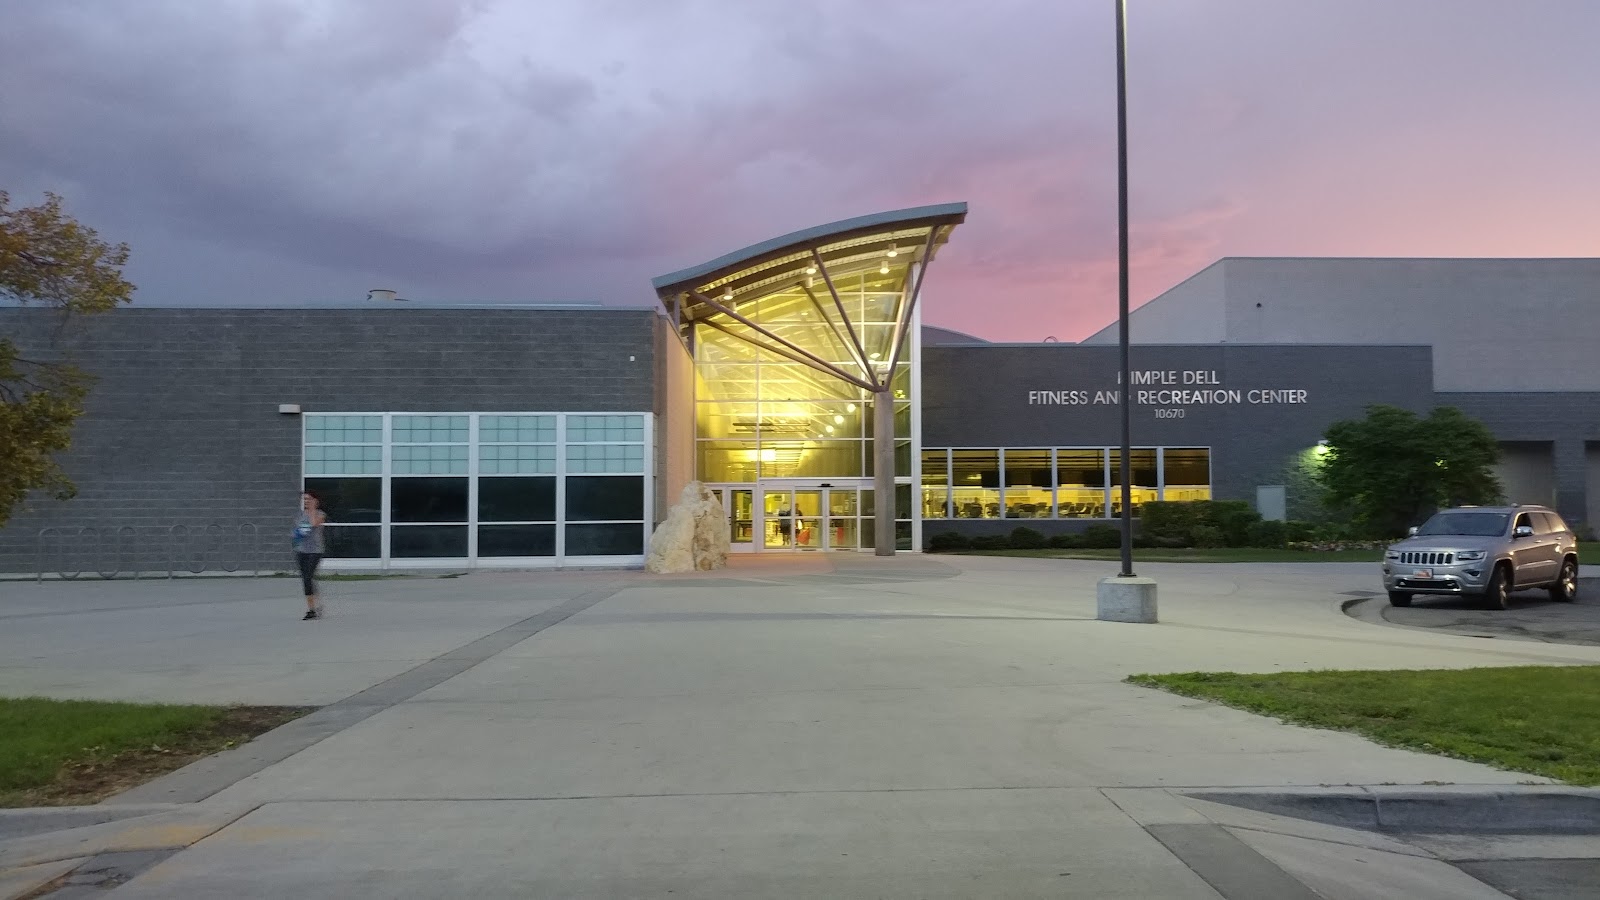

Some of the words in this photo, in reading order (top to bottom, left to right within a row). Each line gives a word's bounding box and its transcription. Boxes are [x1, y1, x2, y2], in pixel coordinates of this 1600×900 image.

[1117, 370, 1177, 385] IMPLE
[1182, 370, 1220, 385] DELL
[1028, 390, 1089, 405] FITNESS
[1093, 390, 1132, 405] AN
[1137, 389, 1241, 405] RECREATION
[1247, 389, 1308, 404] CENTER
[1154, 408, 1185, 419] 10670
